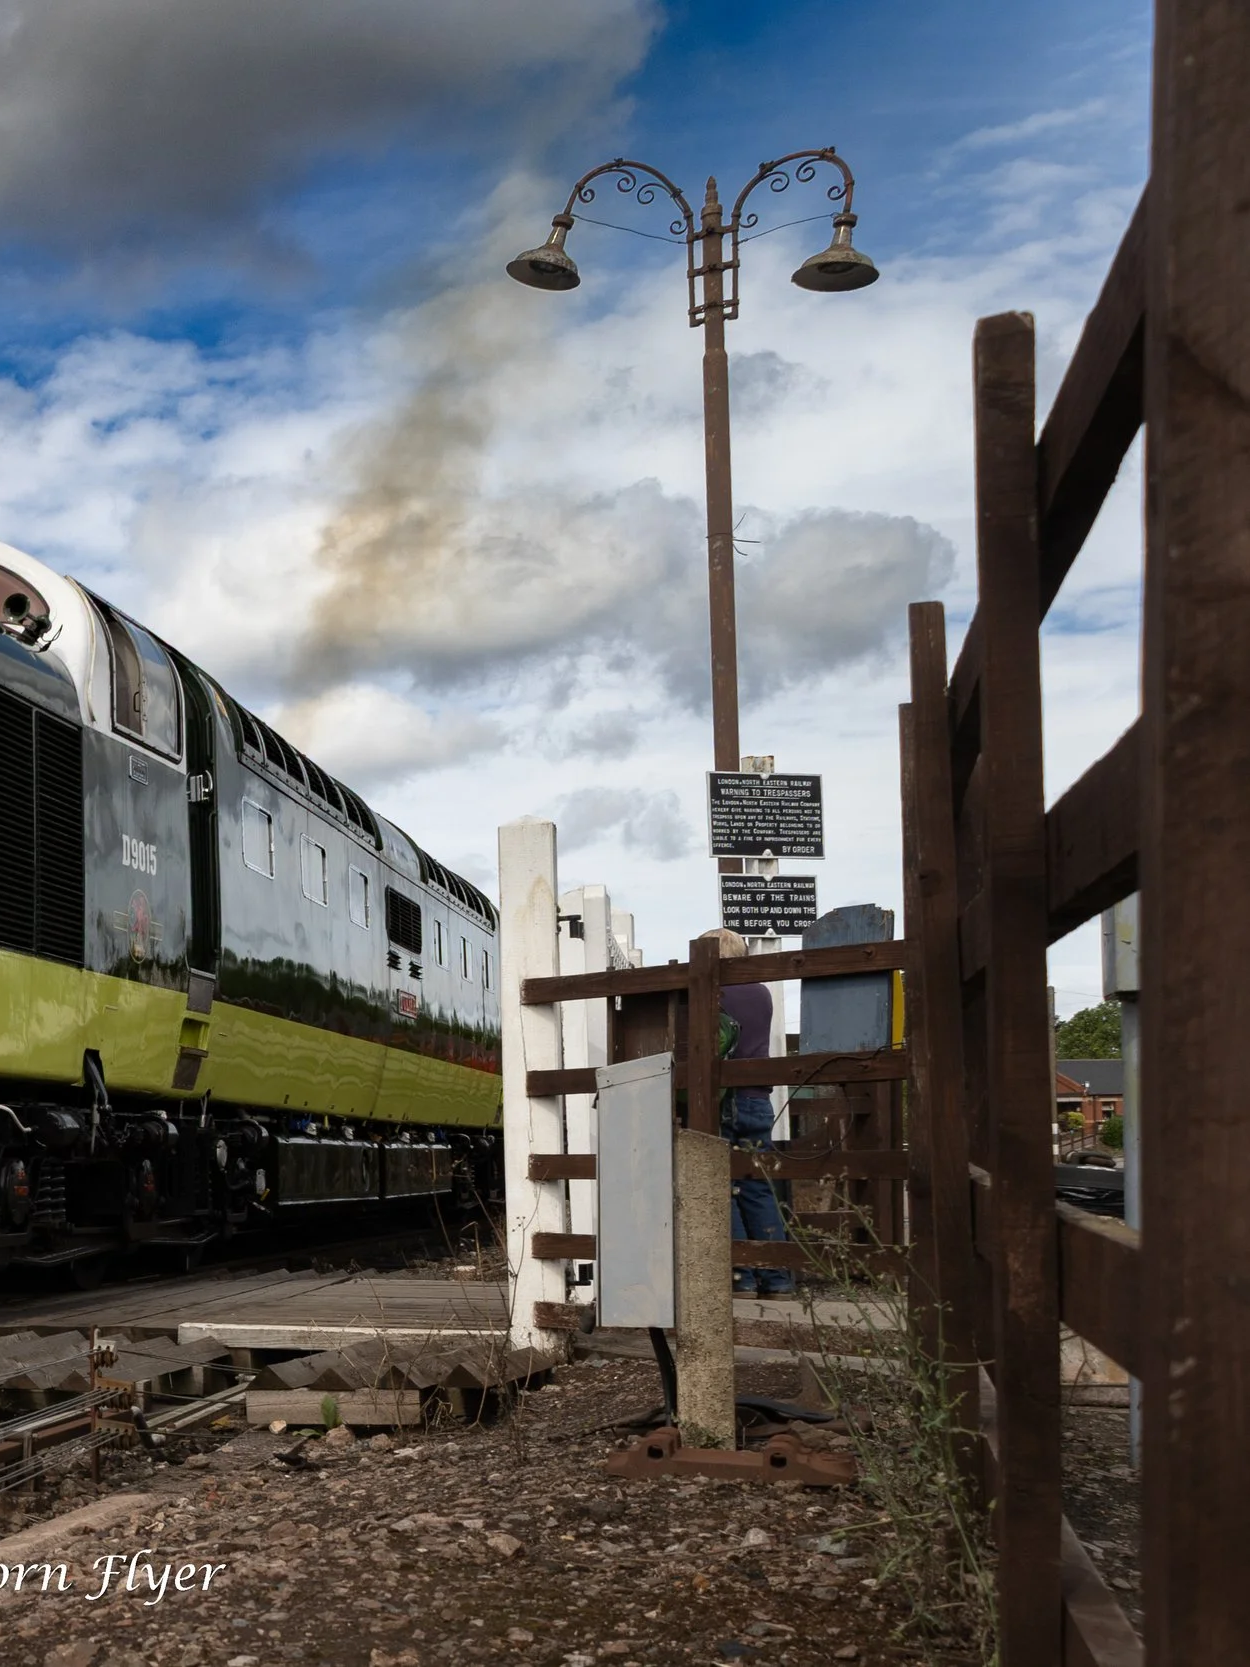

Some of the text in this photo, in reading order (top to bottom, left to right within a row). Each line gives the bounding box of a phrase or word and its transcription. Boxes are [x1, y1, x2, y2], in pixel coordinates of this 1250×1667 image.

[763, 790, 811, 798] TRESPASSERS
[793, 846, 815, 854] ORDER
[122, 834, 157, 876] D9015
[803, 907, 816, 915] THE
[744, 920, 772, 928] BEFORE
[777, 920, 790, 928] YOU
